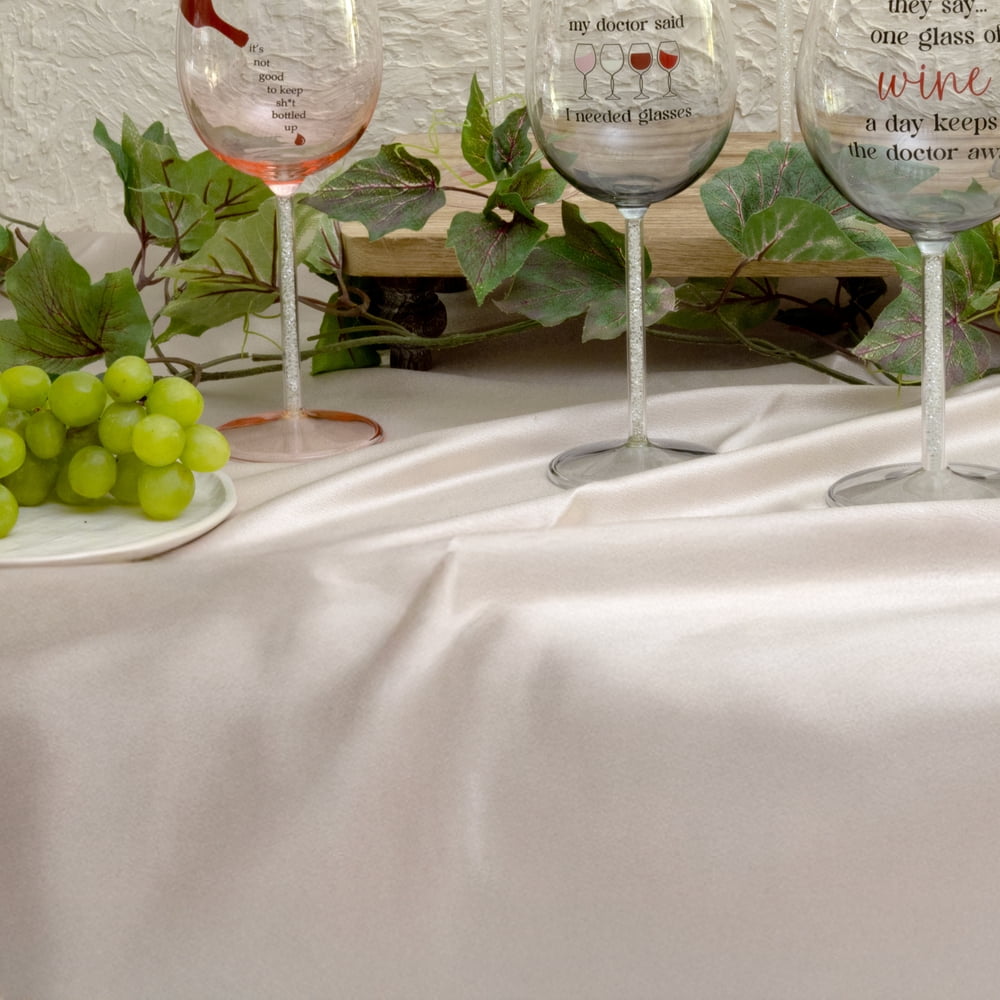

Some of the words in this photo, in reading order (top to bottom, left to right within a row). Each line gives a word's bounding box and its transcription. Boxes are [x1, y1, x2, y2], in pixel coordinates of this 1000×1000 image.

[941, 0, 988, 19] say...
[568, 19, 590, 36] my
[596, 18, 648, 32] doctor
[654, 15, 684, 30] said
[249, 44, 264, 53] it's
[870, 28, 908, 45] one
[918, 26, 975, 52] glass
[258, 72, 284, 82] good
[877, 63, 992, 102] wine
[267, 86, 277, 94] to
[279, 85, 303, 97] keep
[271, 110, 306, 120] bottled
[565, 107, 571, 121] I
[575, 109, 632, 123] needed
[638, 106, 692, 126] glasses
[284, 124, 298, 133] up
[865, 116, 877, 132] a
[885, 114, 925, 138] day
[933, 113, 998, 136] keeps
[848, 141, 878, 159] the
[886, 144, 958, 161] doctor
